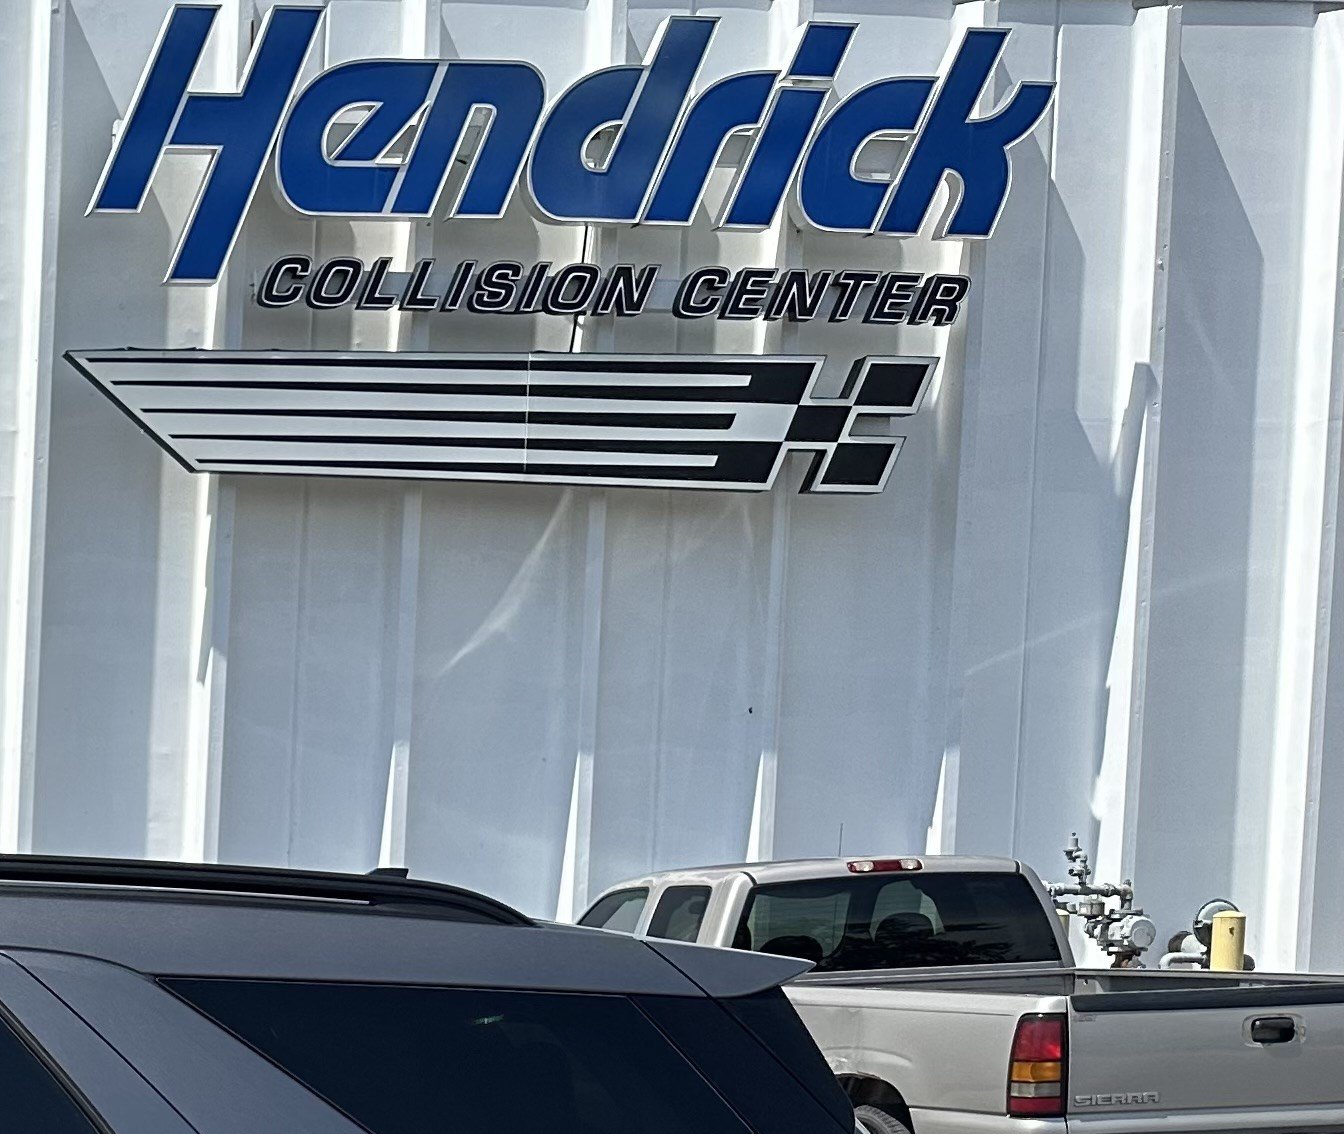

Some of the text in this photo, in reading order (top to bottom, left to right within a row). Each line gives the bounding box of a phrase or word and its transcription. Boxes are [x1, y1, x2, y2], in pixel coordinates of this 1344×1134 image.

[86, 2, 1058, 285] Hendrick
[255, 253, 972, 325] COLLISION CENTER
[1074, 1092, 1160, 1107] SIERRA
